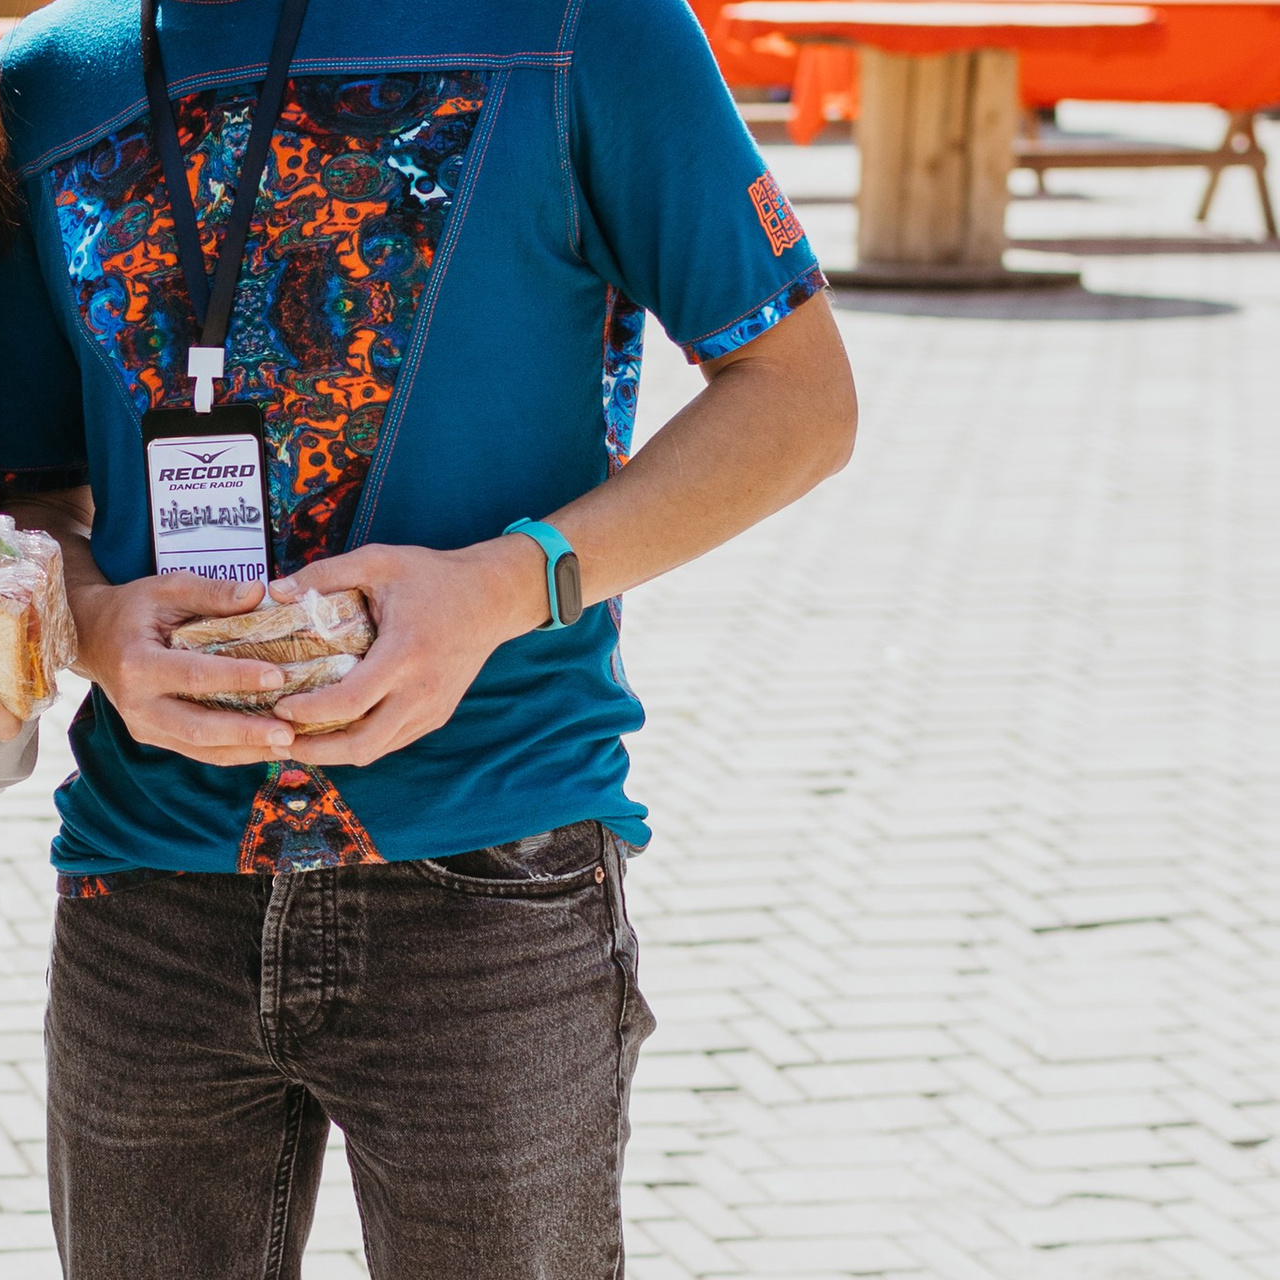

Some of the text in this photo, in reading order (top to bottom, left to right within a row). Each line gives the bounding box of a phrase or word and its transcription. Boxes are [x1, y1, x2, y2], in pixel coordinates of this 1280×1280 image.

[159, 464, 256, 482] RECORD
[169, 480, 243, 491] DANCE RADIO
